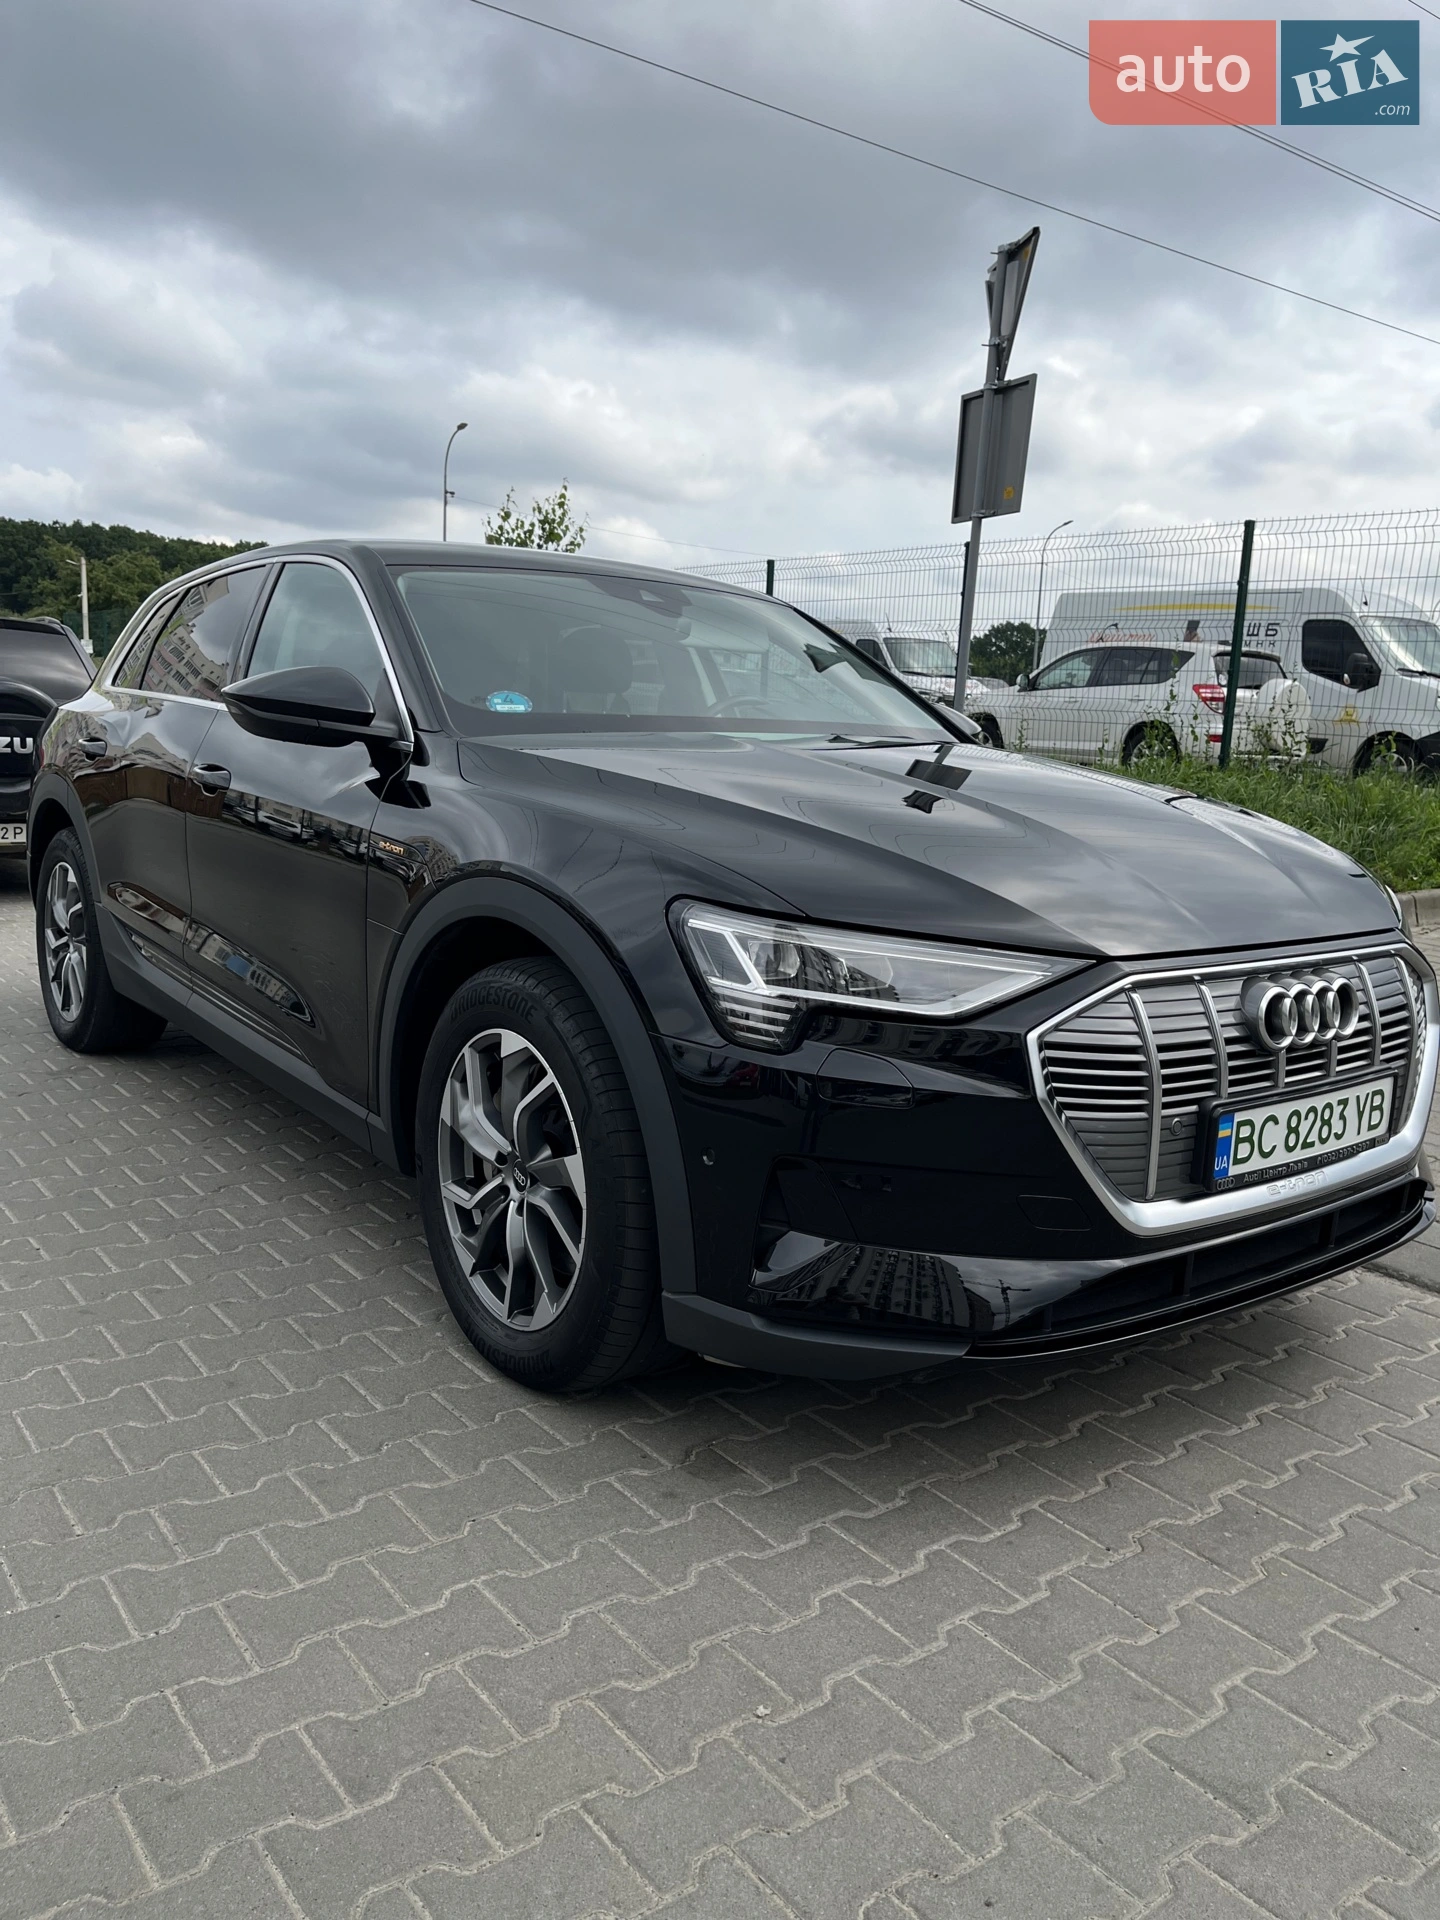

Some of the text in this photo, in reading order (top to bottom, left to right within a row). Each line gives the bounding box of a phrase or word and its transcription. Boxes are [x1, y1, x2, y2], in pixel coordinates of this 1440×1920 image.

[450, 984, 538, 1025] BRIDGESTONE
[1232, 1088, 1385, 1167] BC 8283 YB
[1214, 1155, 1229, 1171] UA
